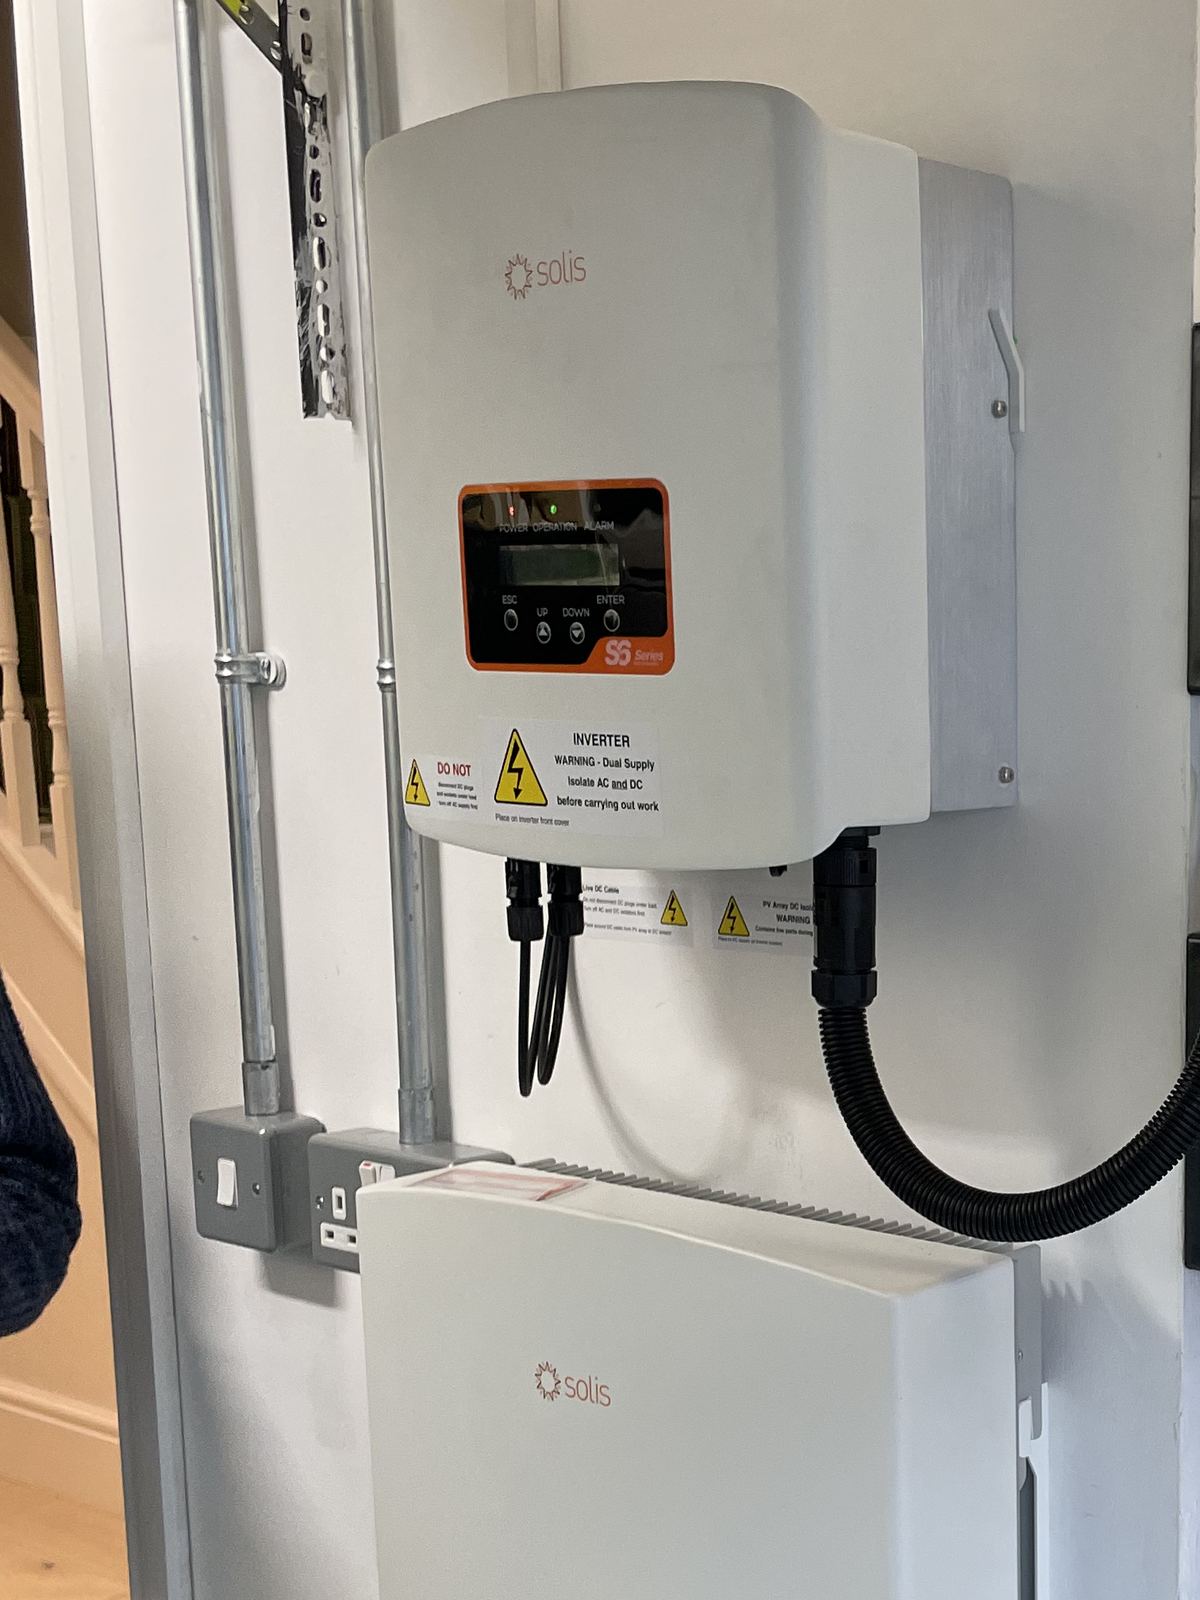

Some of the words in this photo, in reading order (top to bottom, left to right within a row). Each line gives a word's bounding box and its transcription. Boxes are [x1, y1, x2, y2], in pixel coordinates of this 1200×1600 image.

[536, 250, 586, 286] solis
[500, 524, 528, 532] POWER
[532, 522, 578, 532] OPERATION
[584, 520, 614, 530] ALARM
[502, 595, 518, 604] ESC
[596, 594, 625, 605] ENTER
[536, 608, 548, 617] UP
[562, 608, 590, 617] DOWN
[634, 650, 664, 662] Series
[574, 732, 630, 748] INVERTER
[437, 762, 450, 775] DO
[452, 763, 472, 777] NOT
[554, 754, 596, 766] WARNING
[602, 758, 622, 768] Dual
[624, 758, 655, 772] Supply
[568, 776, 594, 787] Isolate
[597, 778, 609, 788] AC
[612, 779, 628, 790] and
[630, 780, 643, 790] DC
[556, 796, 582, 807] before
[584, 798, 619, 812] carrying
[620, 800, 635, 810] out
[637, 802, 659, 812] work
[495, 813, 510, 822] Place
[762, 900, 770, 908] PV
[772, 901, 788, 911] Array
[790, 902, 799, 910] DC
[776, 914, 810, 924] WARNING
[564, 1375, 611, 1407] solis
